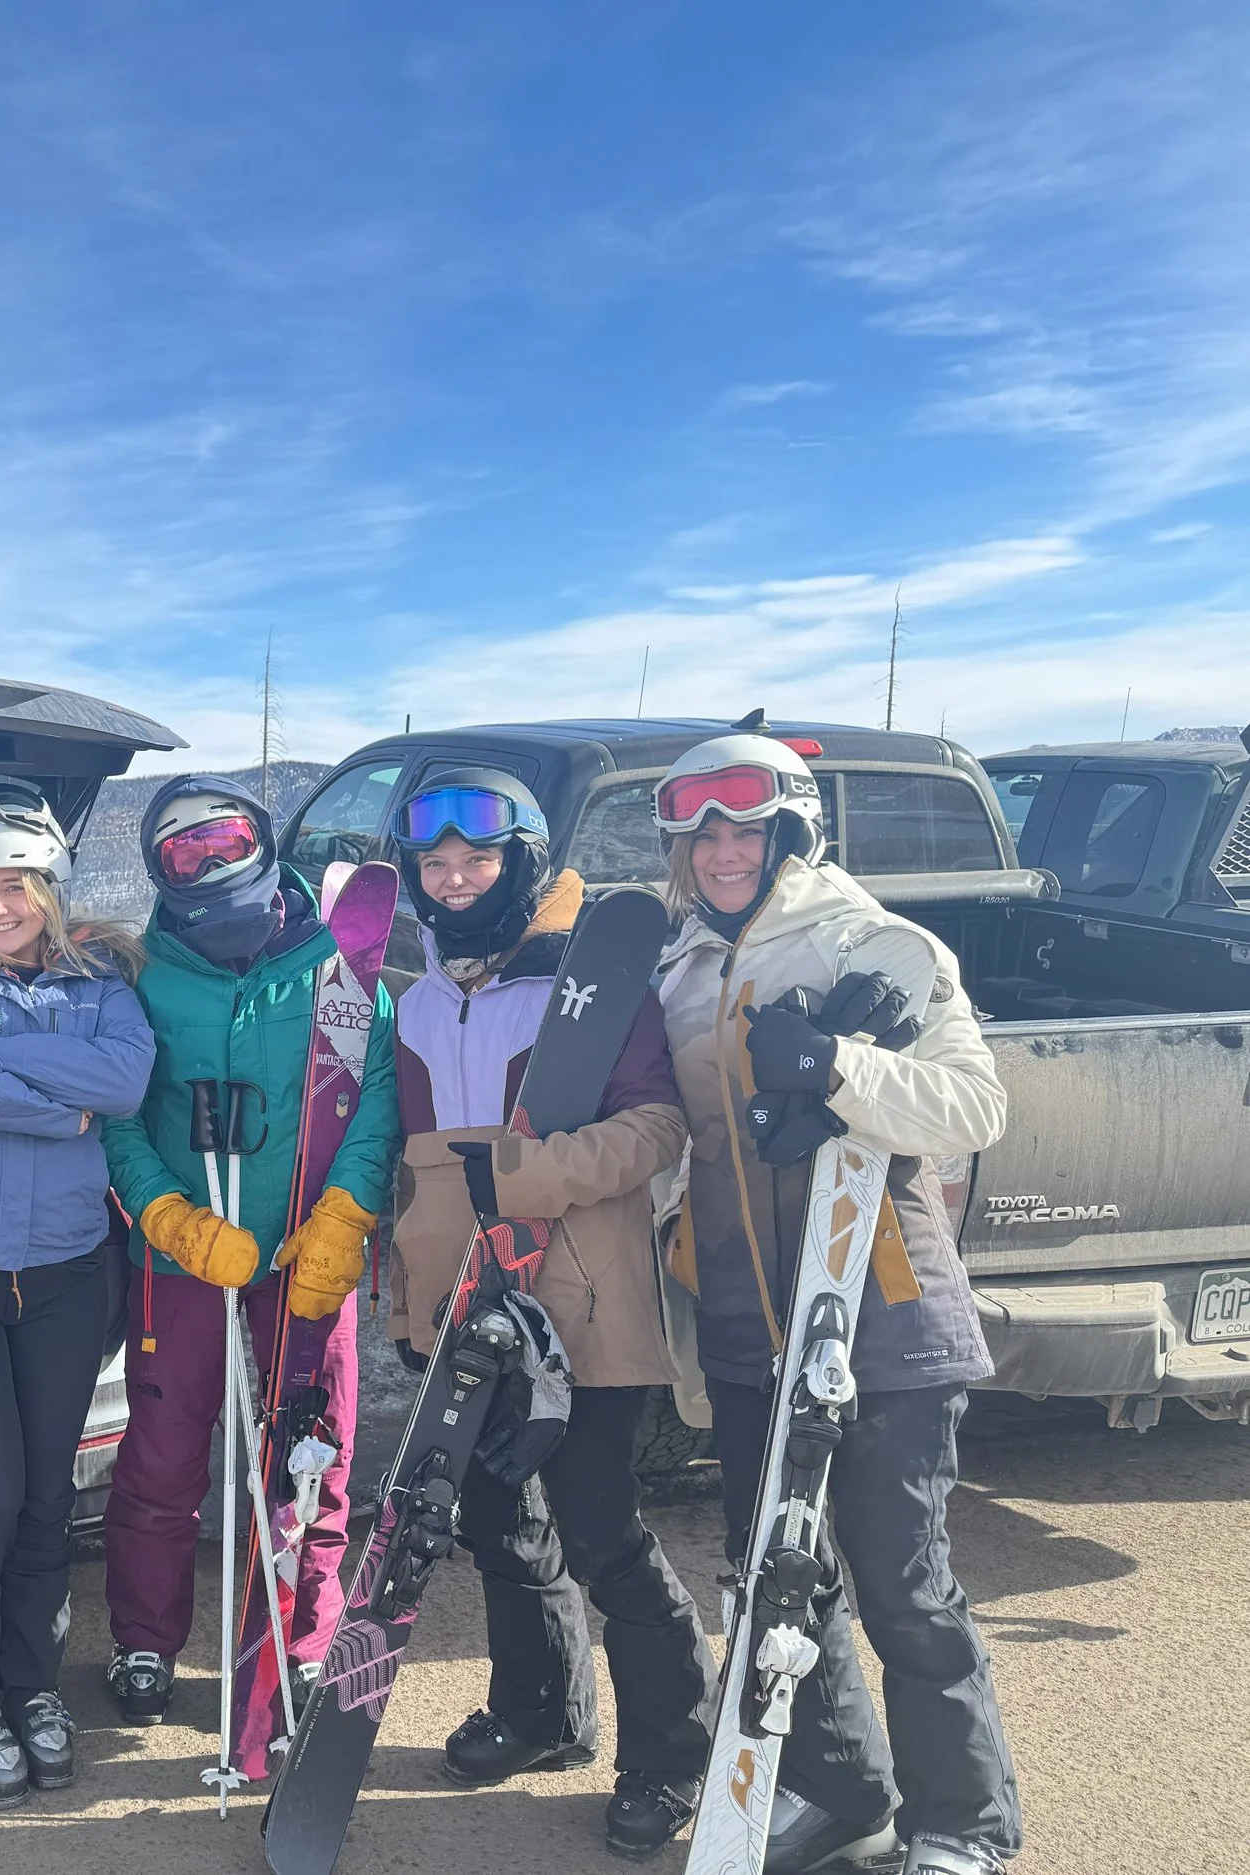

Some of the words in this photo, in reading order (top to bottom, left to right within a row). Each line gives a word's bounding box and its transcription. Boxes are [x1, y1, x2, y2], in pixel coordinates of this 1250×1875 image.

[319, 999, 373, 1018] ATO
[987, 1195, 1047, 1209] TOYOTA
[984, 1204, 1120, 1226] TACOMA
